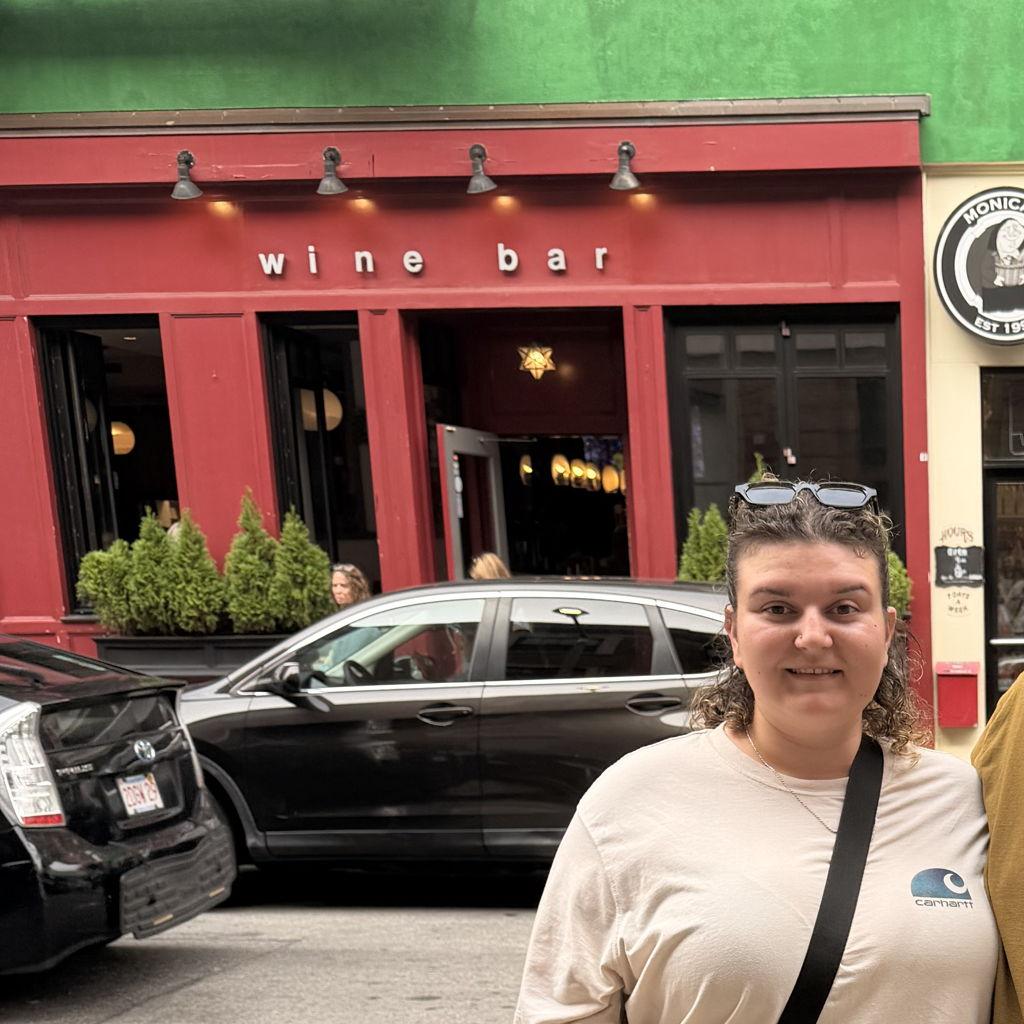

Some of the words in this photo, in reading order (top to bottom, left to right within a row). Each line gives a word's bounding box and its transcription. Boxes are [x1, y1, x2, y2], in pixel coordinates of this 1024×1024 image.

[258, 245, 425, 275] wine
[498, 243, 608, 273] bar
[974, 316, 1000, 334] EST
[940, 526, 974, 543] HOURS
[915, 899, 973, 909] carhartt
